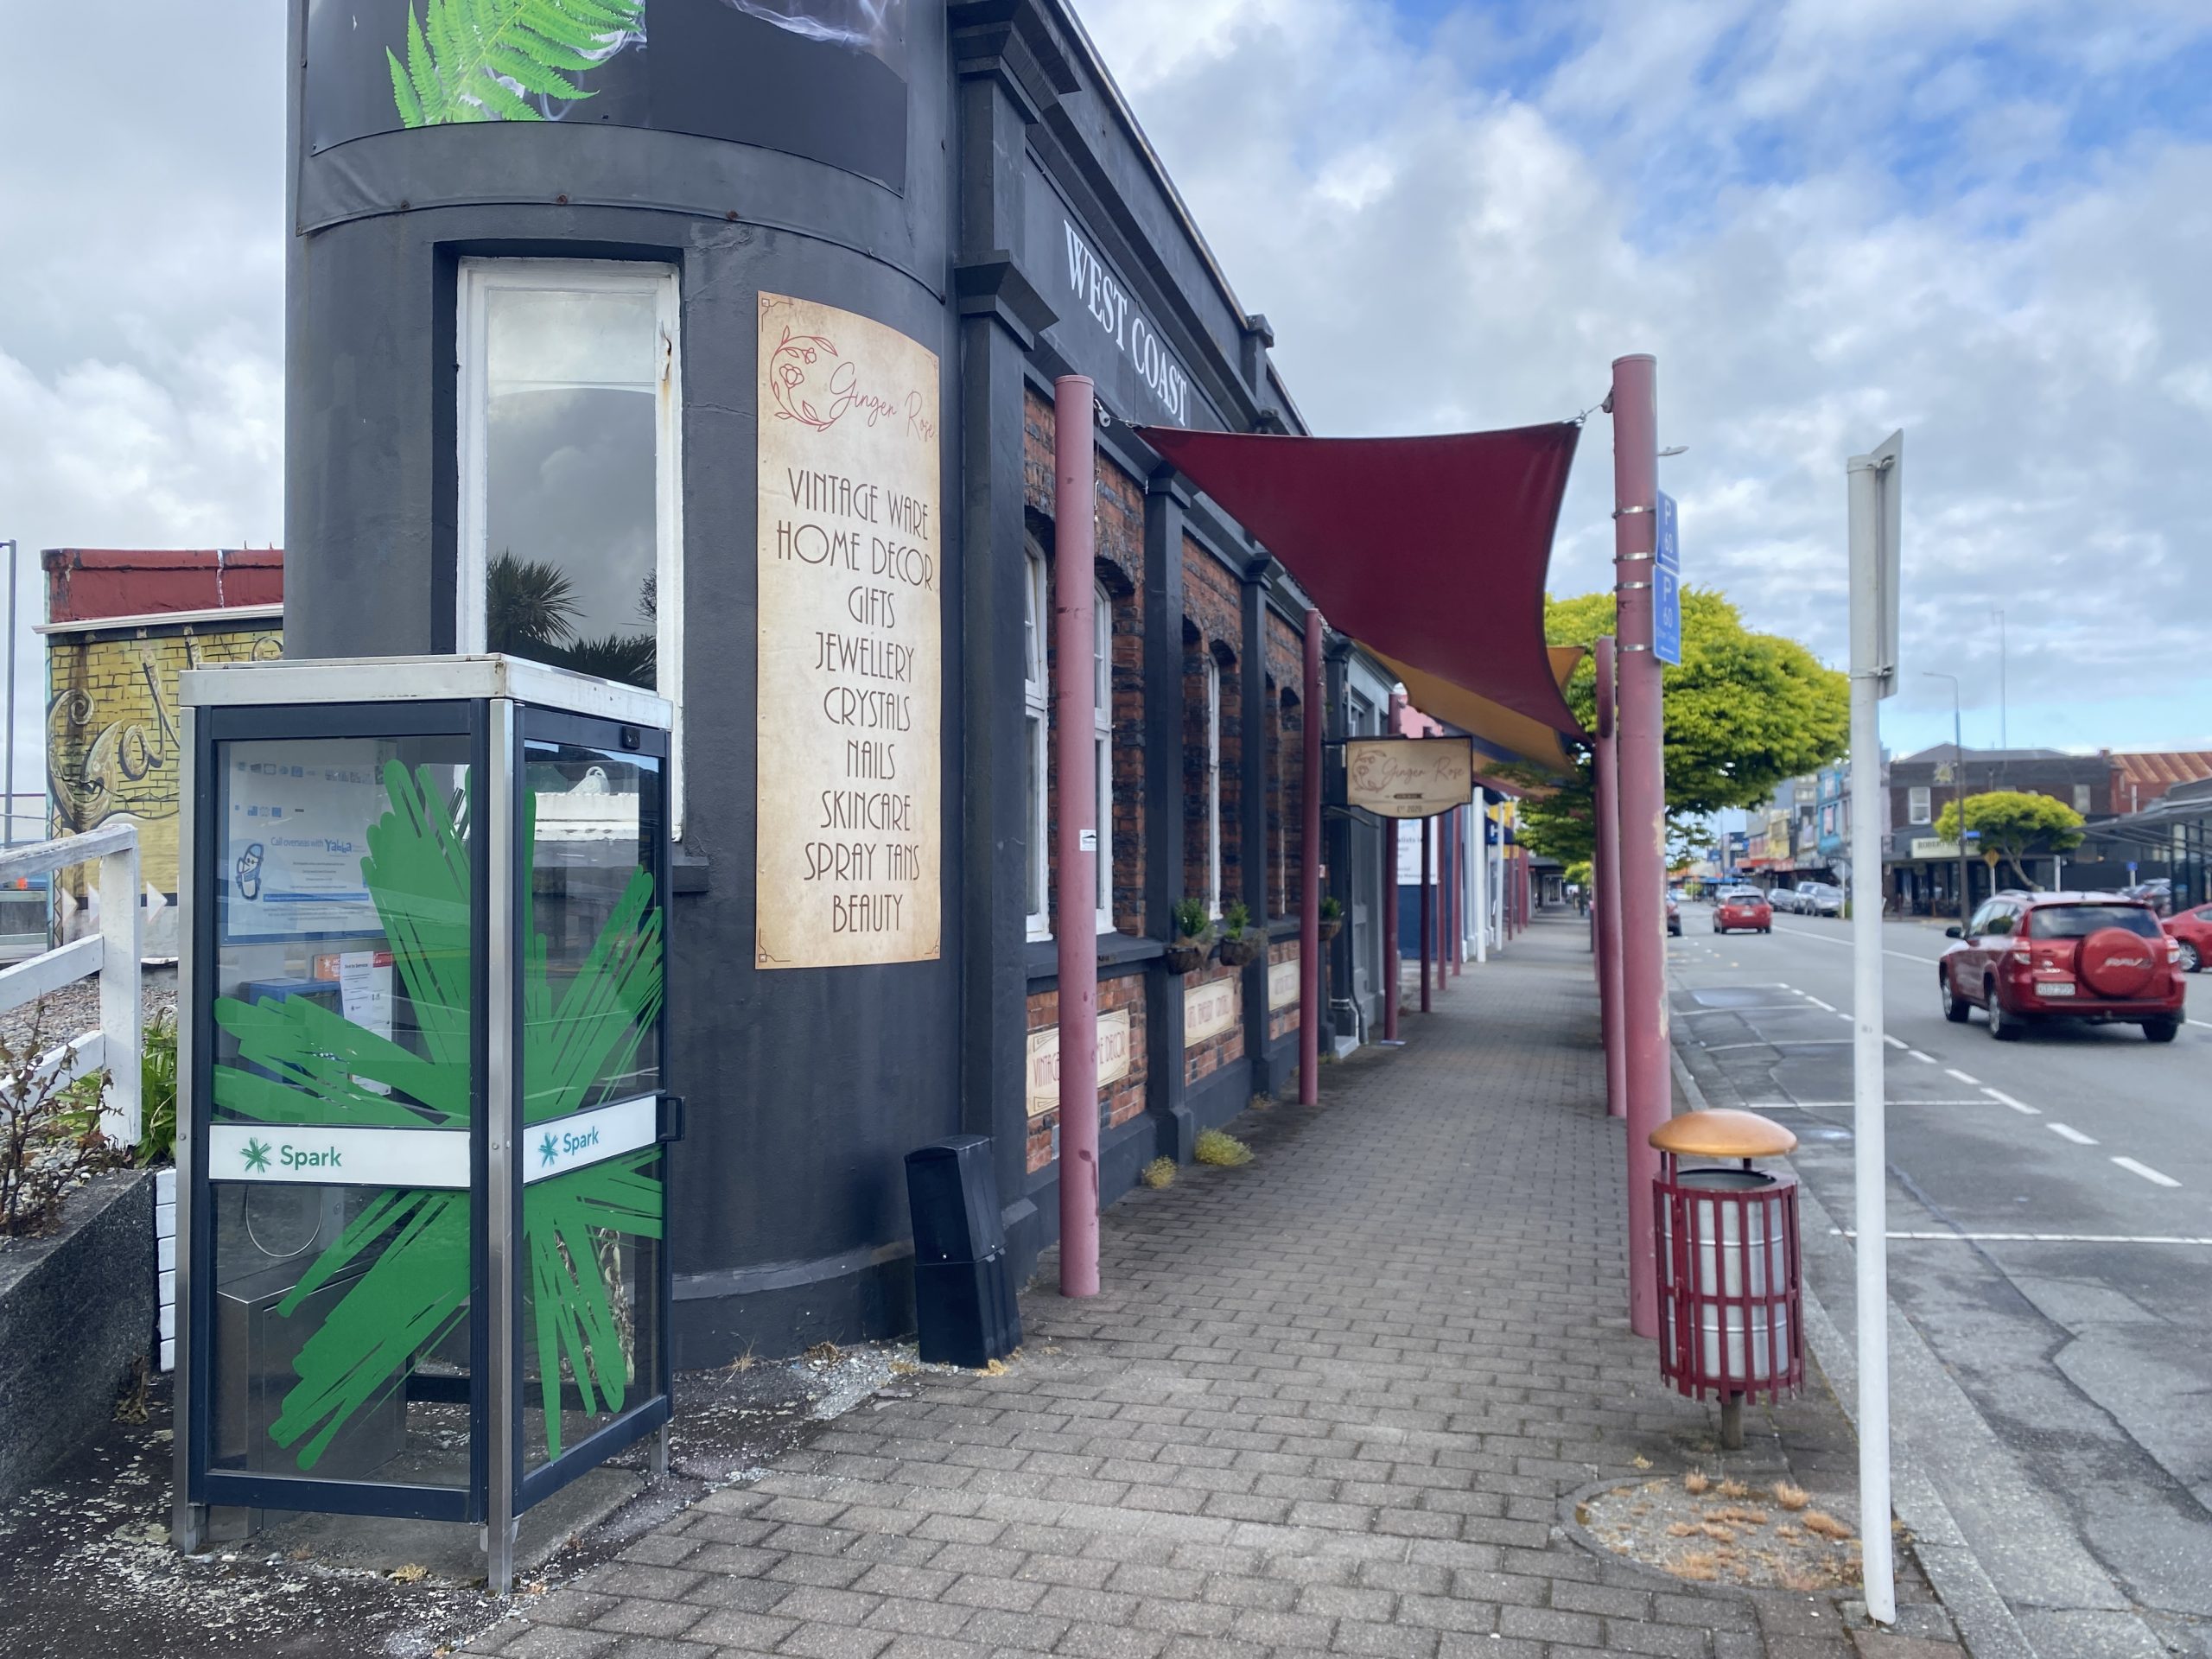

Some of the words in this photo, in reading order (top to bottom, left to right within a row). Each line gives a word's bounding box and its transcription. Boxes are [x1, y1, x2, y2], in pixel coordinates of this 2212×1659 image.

[1064, 219, 1127, 350] WEST
[1132, 318, 1186, 426] COAST
[830, 362, 897, 427] Ginger
[905, 390, 935, 442] Rose
[787, 467, 878, 524] VINTAGE
[887, 490, 928, 540] WARE
[1664, 499, 1672, 524] P
[777, 520, 860, 571] HOME
[872, 537, 933, 591] DECOR
[1664, 532, 1674, 554] 60
[849, 586, 895, 628] GIFTS
[1663, 576, 1672, 602] P
[1662, 607, 1673, 629] 60
[815, 632, 914, 683] JEWELLERY
[823, 687, 911, 731] CRYSTALS
[847, 740, 895, 779] NAILS
[1382, 757, 1426, 787] Ginger
[1433, 756, 1465, 782] Rose
[820, 790, 911, 831] SKINCARE
[270, 836, 283, 846] Call
[324, 838, 352, 854] Yabba
[804, 842, 876, 880] SPRAY
[886, 844, 919, 880] TANS
[832, 893, 903, 933] BEAUTY
[281, 1145, 342, 1171] Spark
[563, 1126, 600, 1155] Spark
